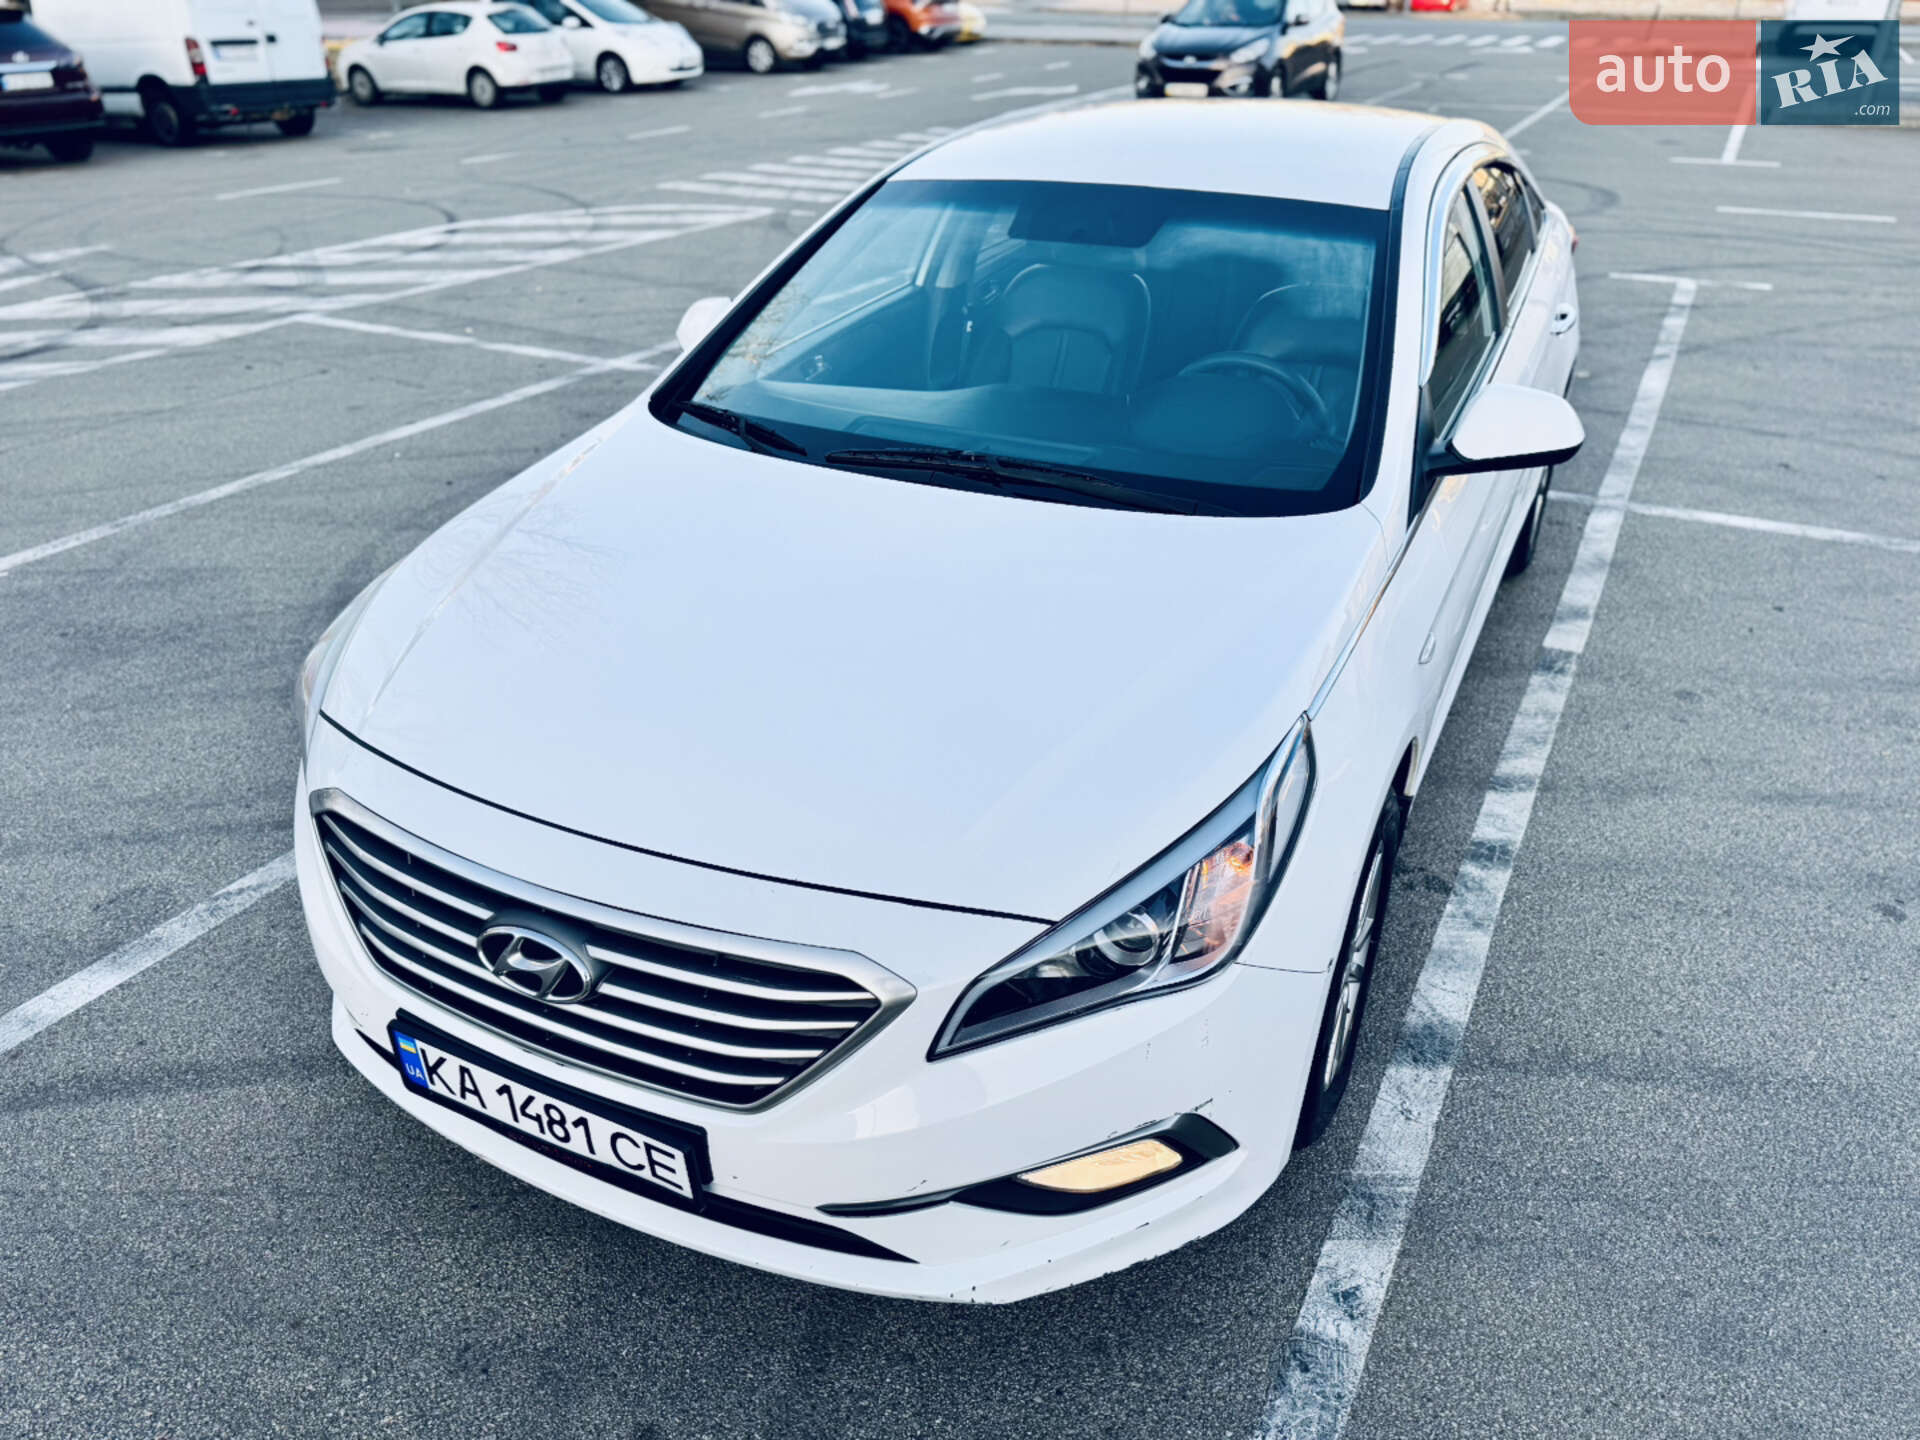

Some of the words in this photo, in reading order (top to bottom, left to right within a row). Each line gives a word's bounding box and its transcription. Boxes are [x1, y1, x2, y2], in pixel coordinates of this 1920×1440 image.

[405, 1063, 425, 1081] UA
[419, 1048, 487, 1110] KA
[496, 1083, 596, 1155] 1481
[610, 1131, 684, 1191] CE
